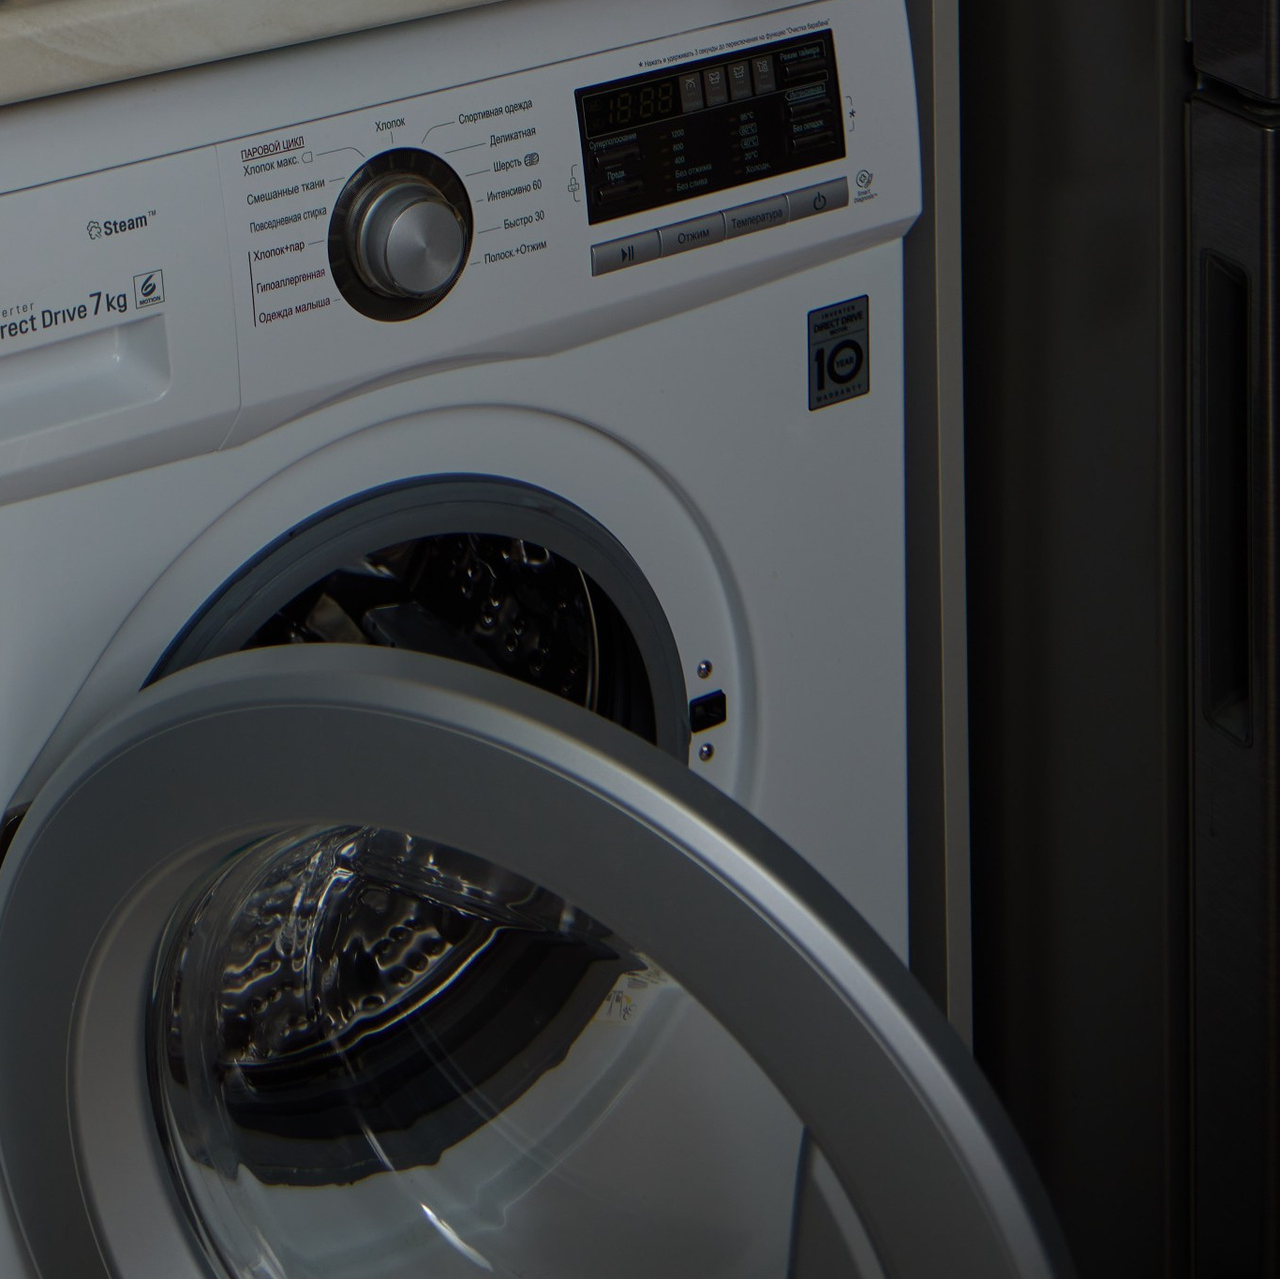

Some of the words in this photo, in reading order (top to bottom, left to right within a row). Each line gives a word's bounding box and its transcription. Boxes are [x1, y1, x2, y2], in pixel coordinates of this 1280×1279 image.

[458, 105, 503, 125] Спортивная
[505, 99, 533, 115] одежда
[375, 117, 406, 132] Хлопок
[671, 129, 684, 138] 1200
[489, 127, 536, 146] Деликатная
[241, 142, 279, 159] ПАРОВОЙ
[281, 136, 305, 150] ЦИКЛ
[243, 162, 276, 176] Хлопок
[277, 156, 299, 169] макс.
[493, 158, 521, 172] Шерсть
[674, 156, 685, 165] 400
[247, 185, 299, 206] Смешанные
[302, 179, 325, 191] ткани
[487, 184, 530, 202] Интенсивно
[532, 180, 542, 191] 60
[250, 213, 302, 233] Повседневная
[303, 207, 327, 221] стирка
[504, 216, 533, 230] Быстро
[535, 211, 545, 222] 30
[731, 208, 783, 230] Температура
[678, 228, 709, 244] Отжим
[253, 240, 305, 262] Хлопок+пар
[257, 269, 325, 293] Гипоаллергенная
[139, 296, 161, 305] MOTION
[259, 307, 293, 324] Одежда
[295, 297, 330, 315] малыша
[42, 304, 87, 329] Drive
[814, 319, 840, 333] DIRECT
[842, 311, 864, 324] DRIVE
[822, 306, 855, 319] INVERTER
[816, 339, 863, 390] 10
[836, 356, 854, 368] YEAR
[817, 384, 862, 402] WARRANTY
